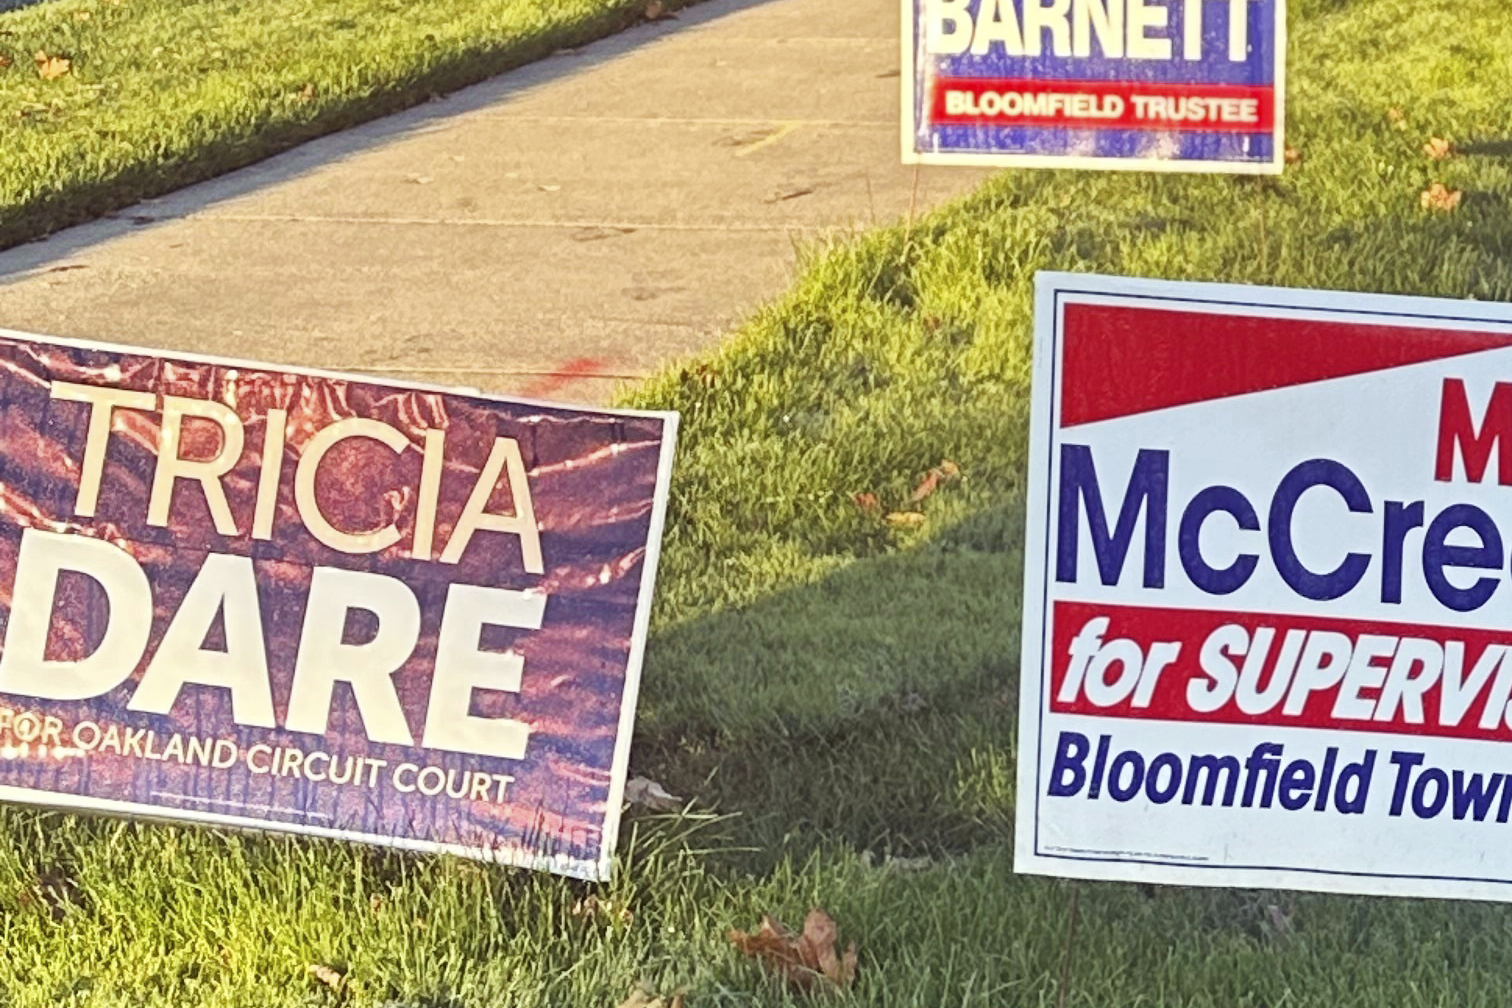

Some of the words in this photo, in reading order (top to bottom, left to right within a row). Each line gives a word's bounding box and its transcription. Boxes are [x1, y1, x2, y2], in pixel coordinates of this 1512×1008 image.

[945, 90, 1124, 119] BLOOMFIELD
[1130, 95, 1259, 123] TRUSTEE
[50, 379, 545, 575] TRICIA
[0, 527, 549, 761] DARE
[1056, 616, 1181, 709] for
[72, 720, 239, 770] OAKLAND
[246, 743, 387, 789] CIRCUIT
[392, 763, 516, 806] COURT
[1047, 731, 1377, 815] Bloomfield
